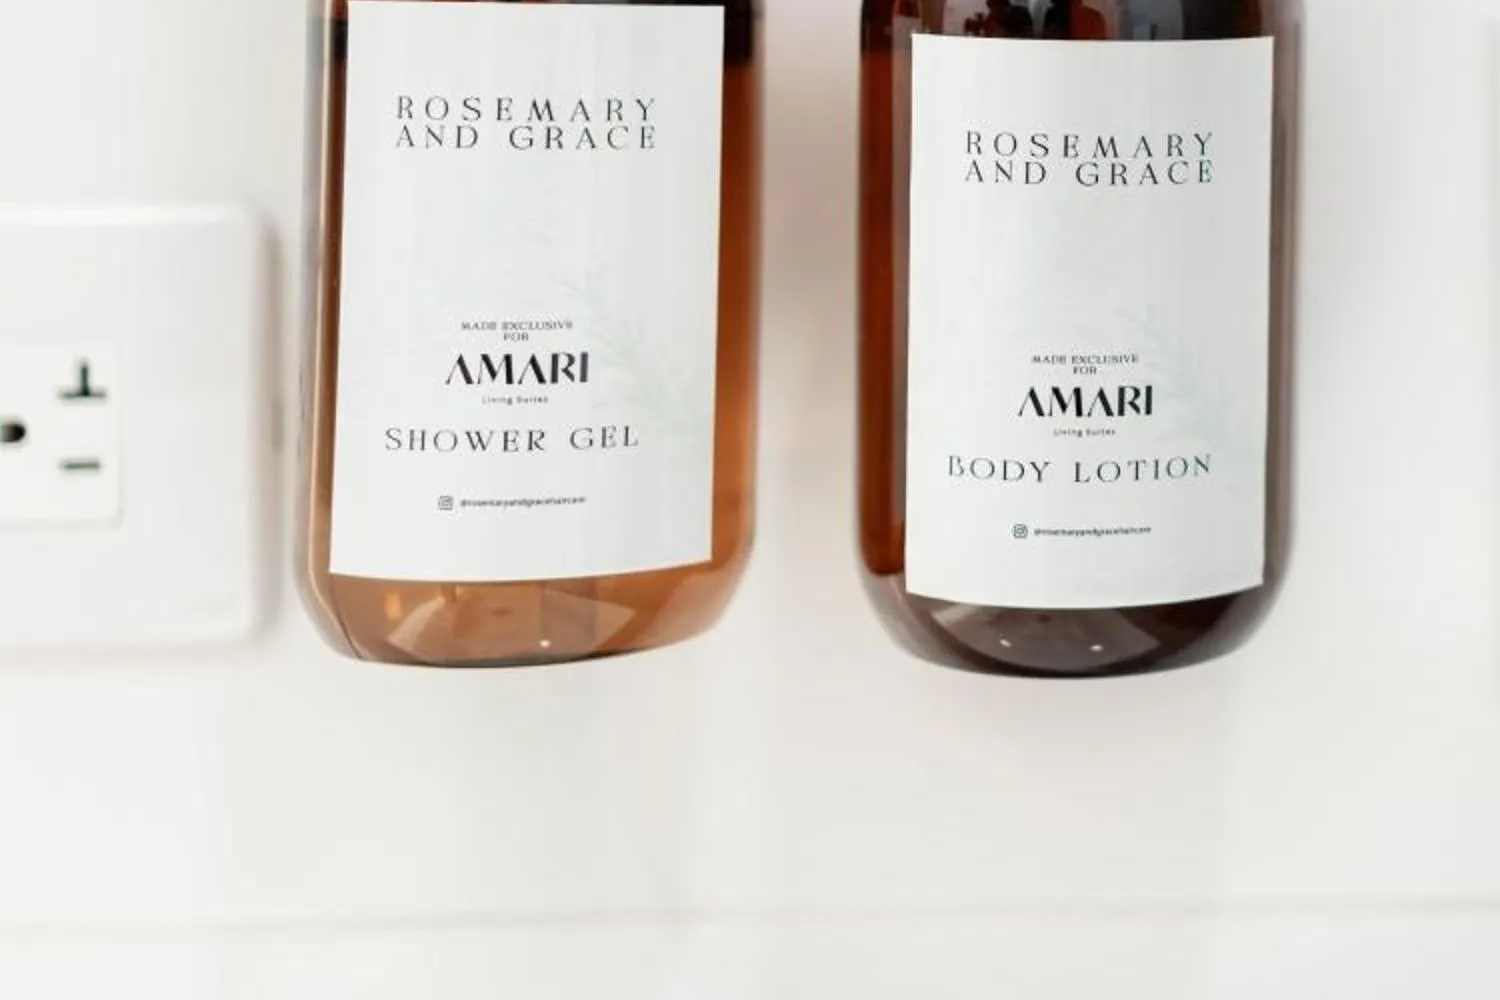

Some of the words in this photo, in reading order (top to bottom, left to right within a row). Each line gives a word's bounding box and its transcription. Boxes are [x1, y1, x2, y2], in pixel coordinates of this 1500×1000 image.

[397, 95, 655, 122] ROSEMARY
[396, 124, 479, 150] AND
[509, 125, 655, 151] GRACE
[966, 130, 1213, 158] ROSEMARY
[965, 160, 1047, 184] AND
[1075, 159, 1213, 187] GRACE
[461, 321, 497, 331] MADE
[501, 320, 573, 331] EXCLUSIVE
[503, 332, 529, 342] FOR
[445, 351, 589, 385] AMARI
[1031, 354, 1067, 365] MADE
[1071, 354, 1139, 365] EXCLUSIVE
[1073, 365, 1098, 375] FOR
[482, 396, 513, 406] Living
[1018, 384, 1153, 418] AMARI
[385, 427, 546, 453] SHOWER
[569, 425, 639, 451] GEL
[1053, 428, 1083, 438] Living
[948, 455, 1051, 484] BODY
[1074, 454, 1211, 484] LOTION
